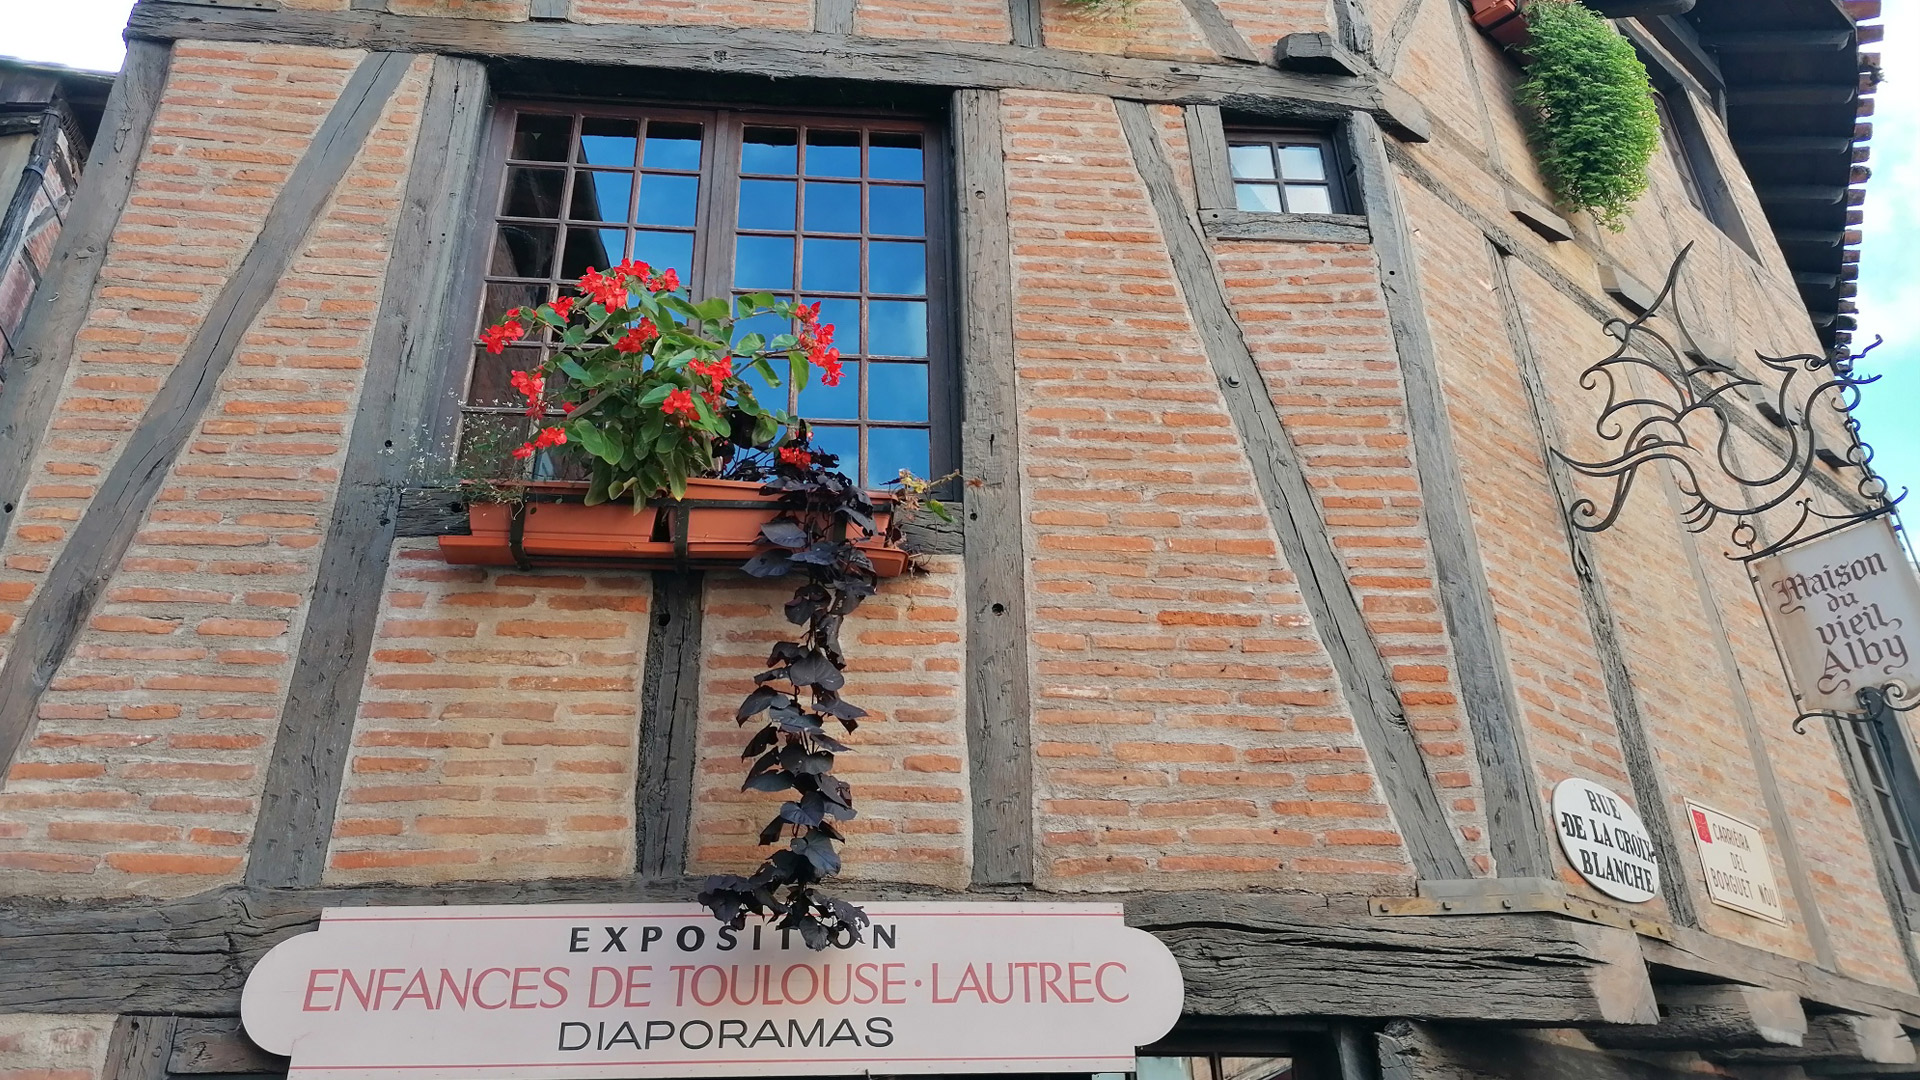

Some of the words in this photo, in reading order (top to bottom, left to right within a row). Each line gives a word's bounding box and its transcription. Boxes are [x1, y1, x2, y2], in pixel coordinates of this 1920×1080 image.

[1771, 552, 1888, 614] Maison
[1826, 592, 1860, 613] du
[1815, 603, 1903, 646] vieil
[1817, 634, 1909, 695] Alby
[1584, 788, 1622, 821] RUE
[1561, 811, 1587, 840] DE
[1589, 818, 1614, 848] LA
[1614, 827, 1655, 864] CROIX
[1579, 848, 1655, 894] BLANCHE
[1729, 851, 1747, 874] DEL
[1710, 867, 1753, 900] BORGUET
[568, 923, 897, 953] EXPOSITON
[302, 966, 570, 1012] ENFANCES
[588, 965, 652, 1008] DE
[558, 1016, 894, 1051] DIAPORAMAS
